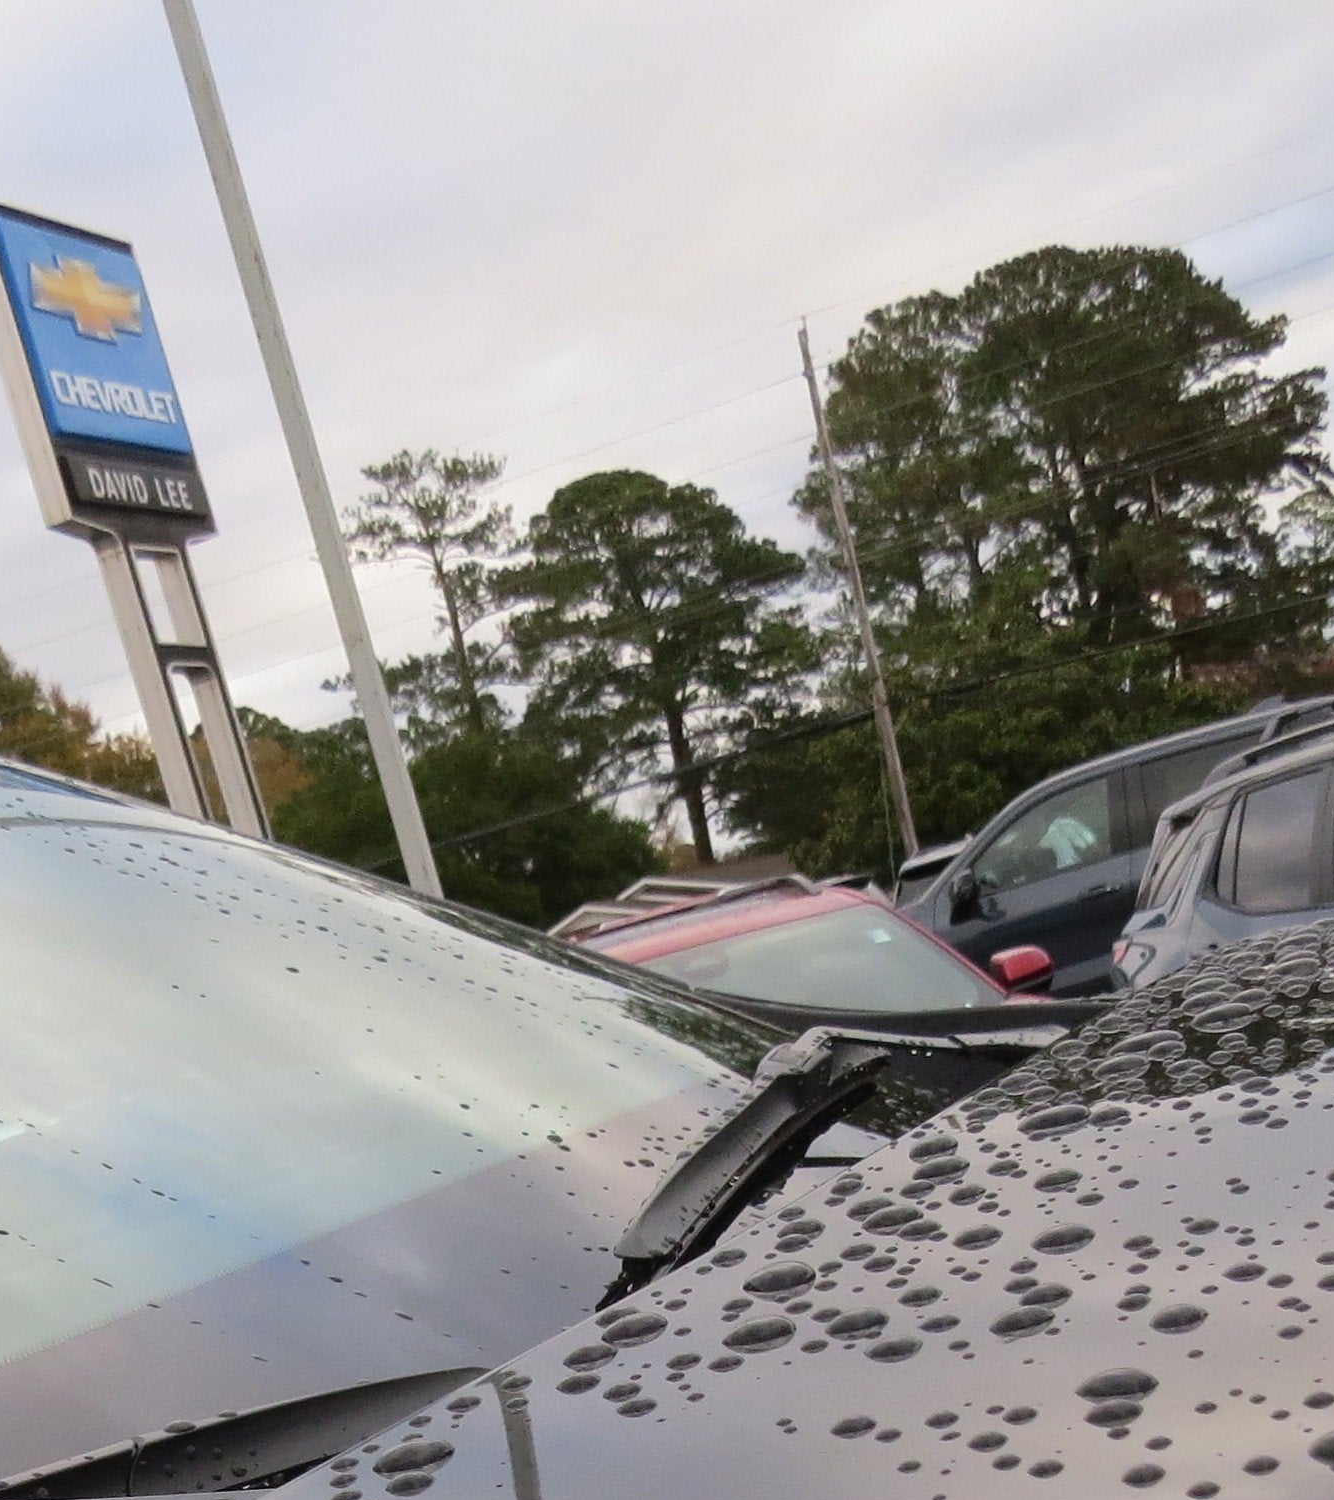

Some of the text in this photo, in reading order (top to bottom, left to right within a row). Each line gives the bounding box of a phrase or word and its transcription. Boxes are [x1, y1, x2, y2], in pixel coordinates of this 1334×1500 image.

[50, 370, 177, 424] CHEVROLET
[87, 466, 193, 510] DAVID LEE
